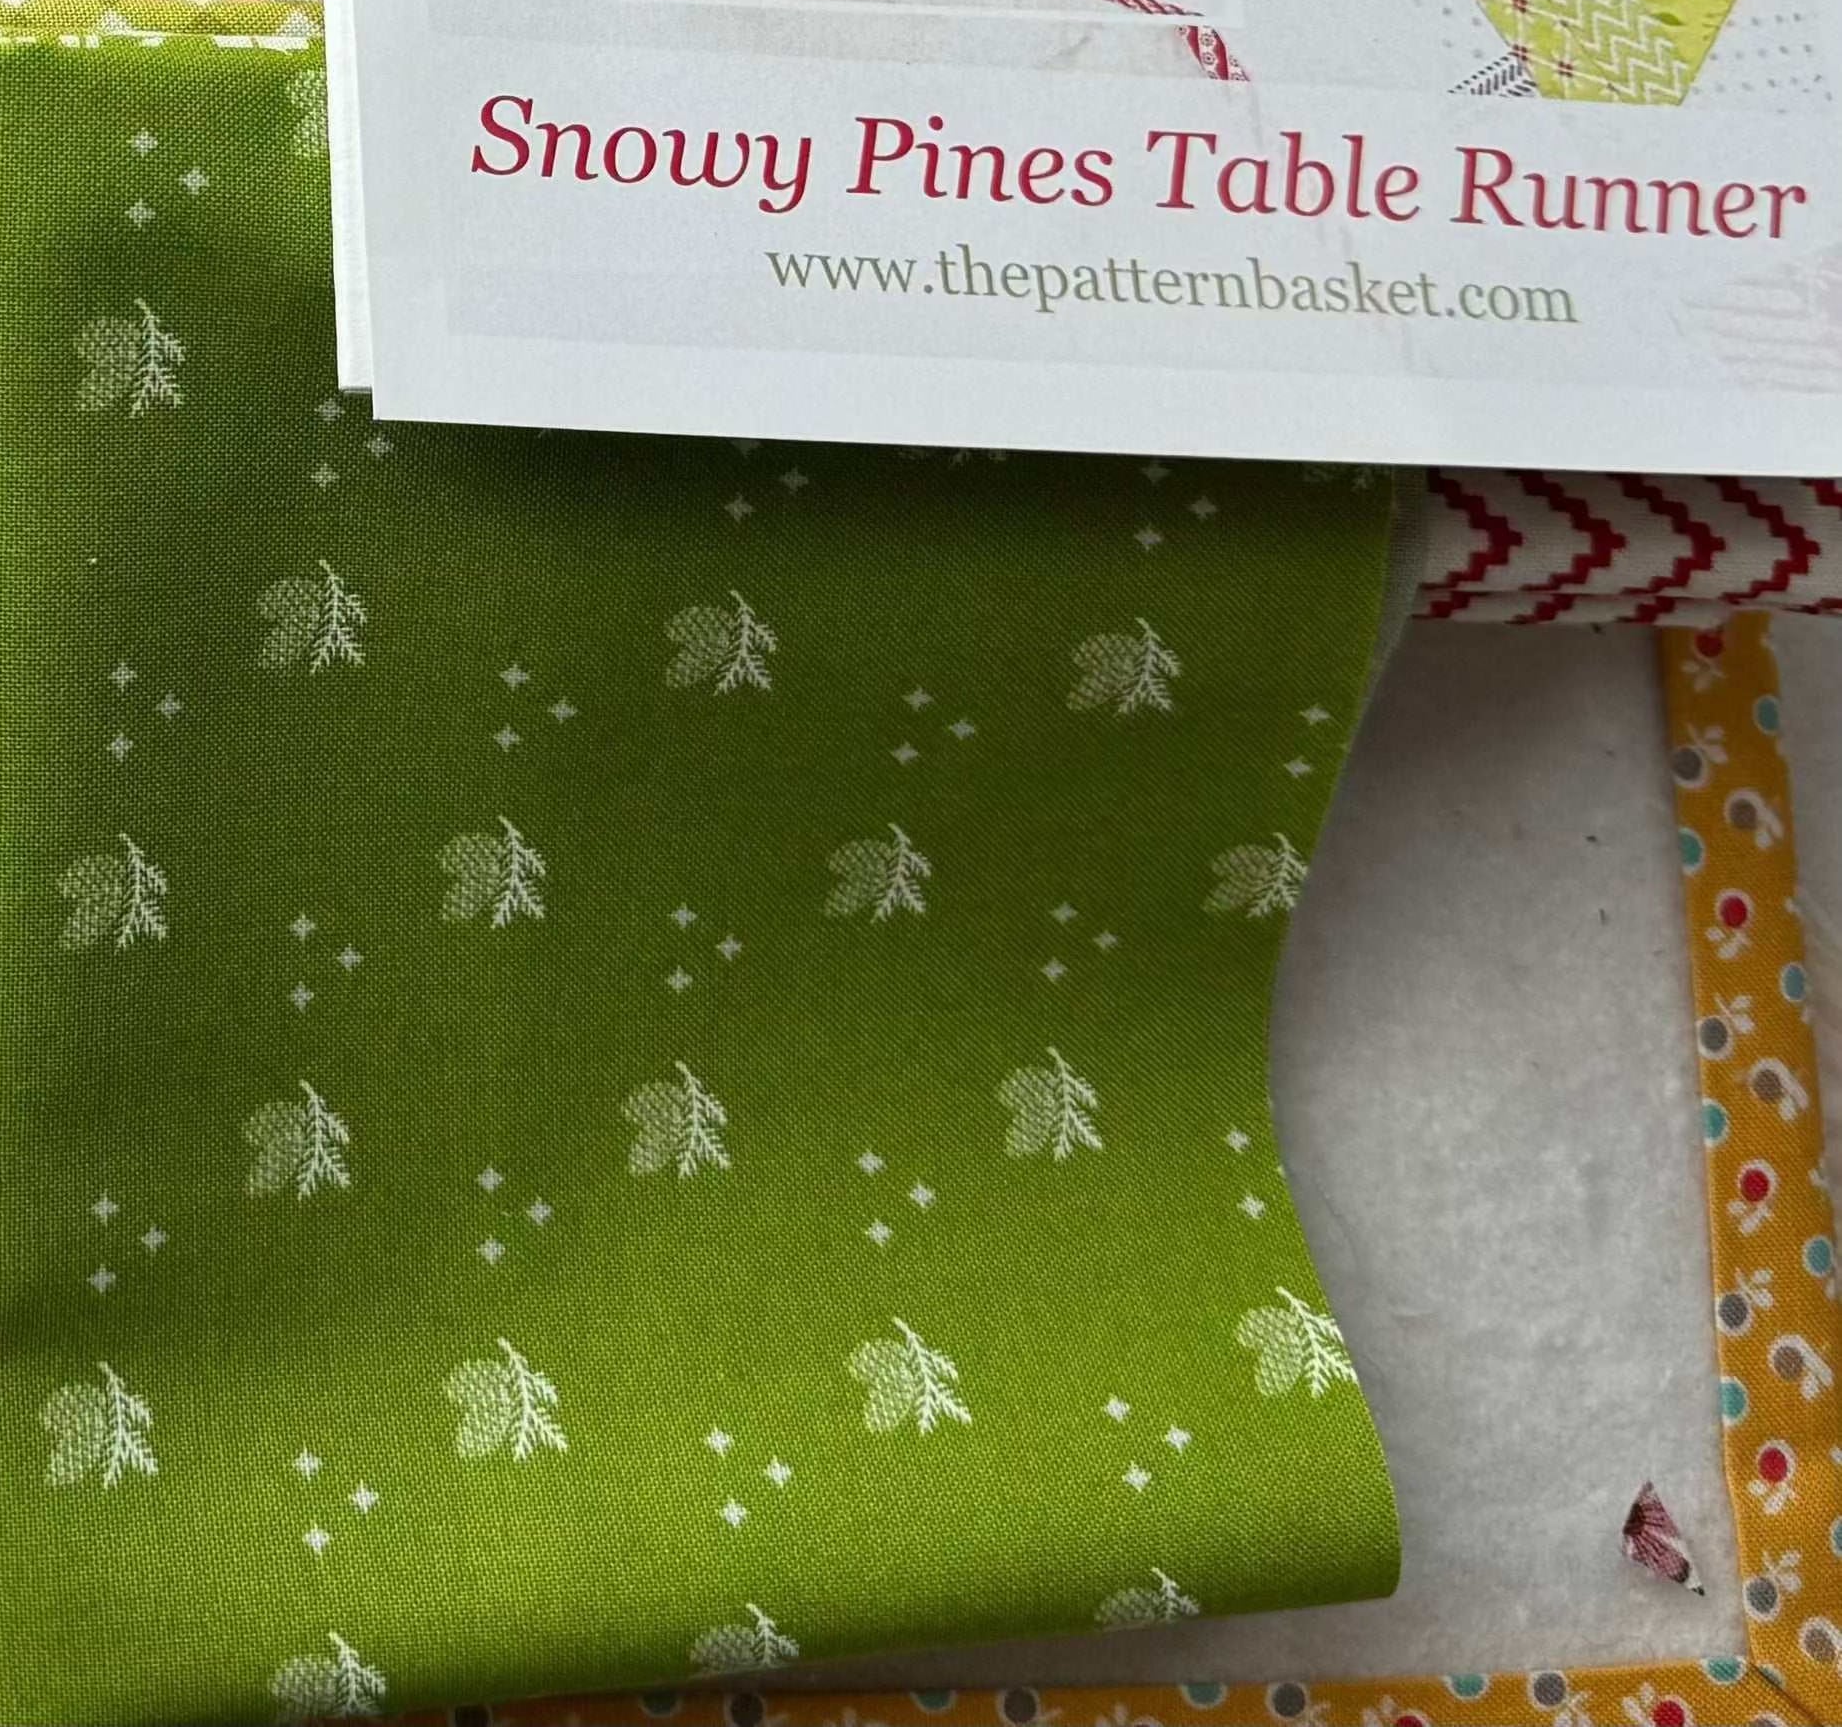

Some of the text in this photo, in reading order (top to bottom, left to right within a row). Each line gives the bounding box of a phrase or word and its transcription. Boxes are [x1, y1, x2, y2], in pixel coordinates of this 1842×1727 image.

[470, 94, 1807, 240] Snowy Pines Table Runner
[765, 243, 1580, 323] www.thepatternbasket.com
